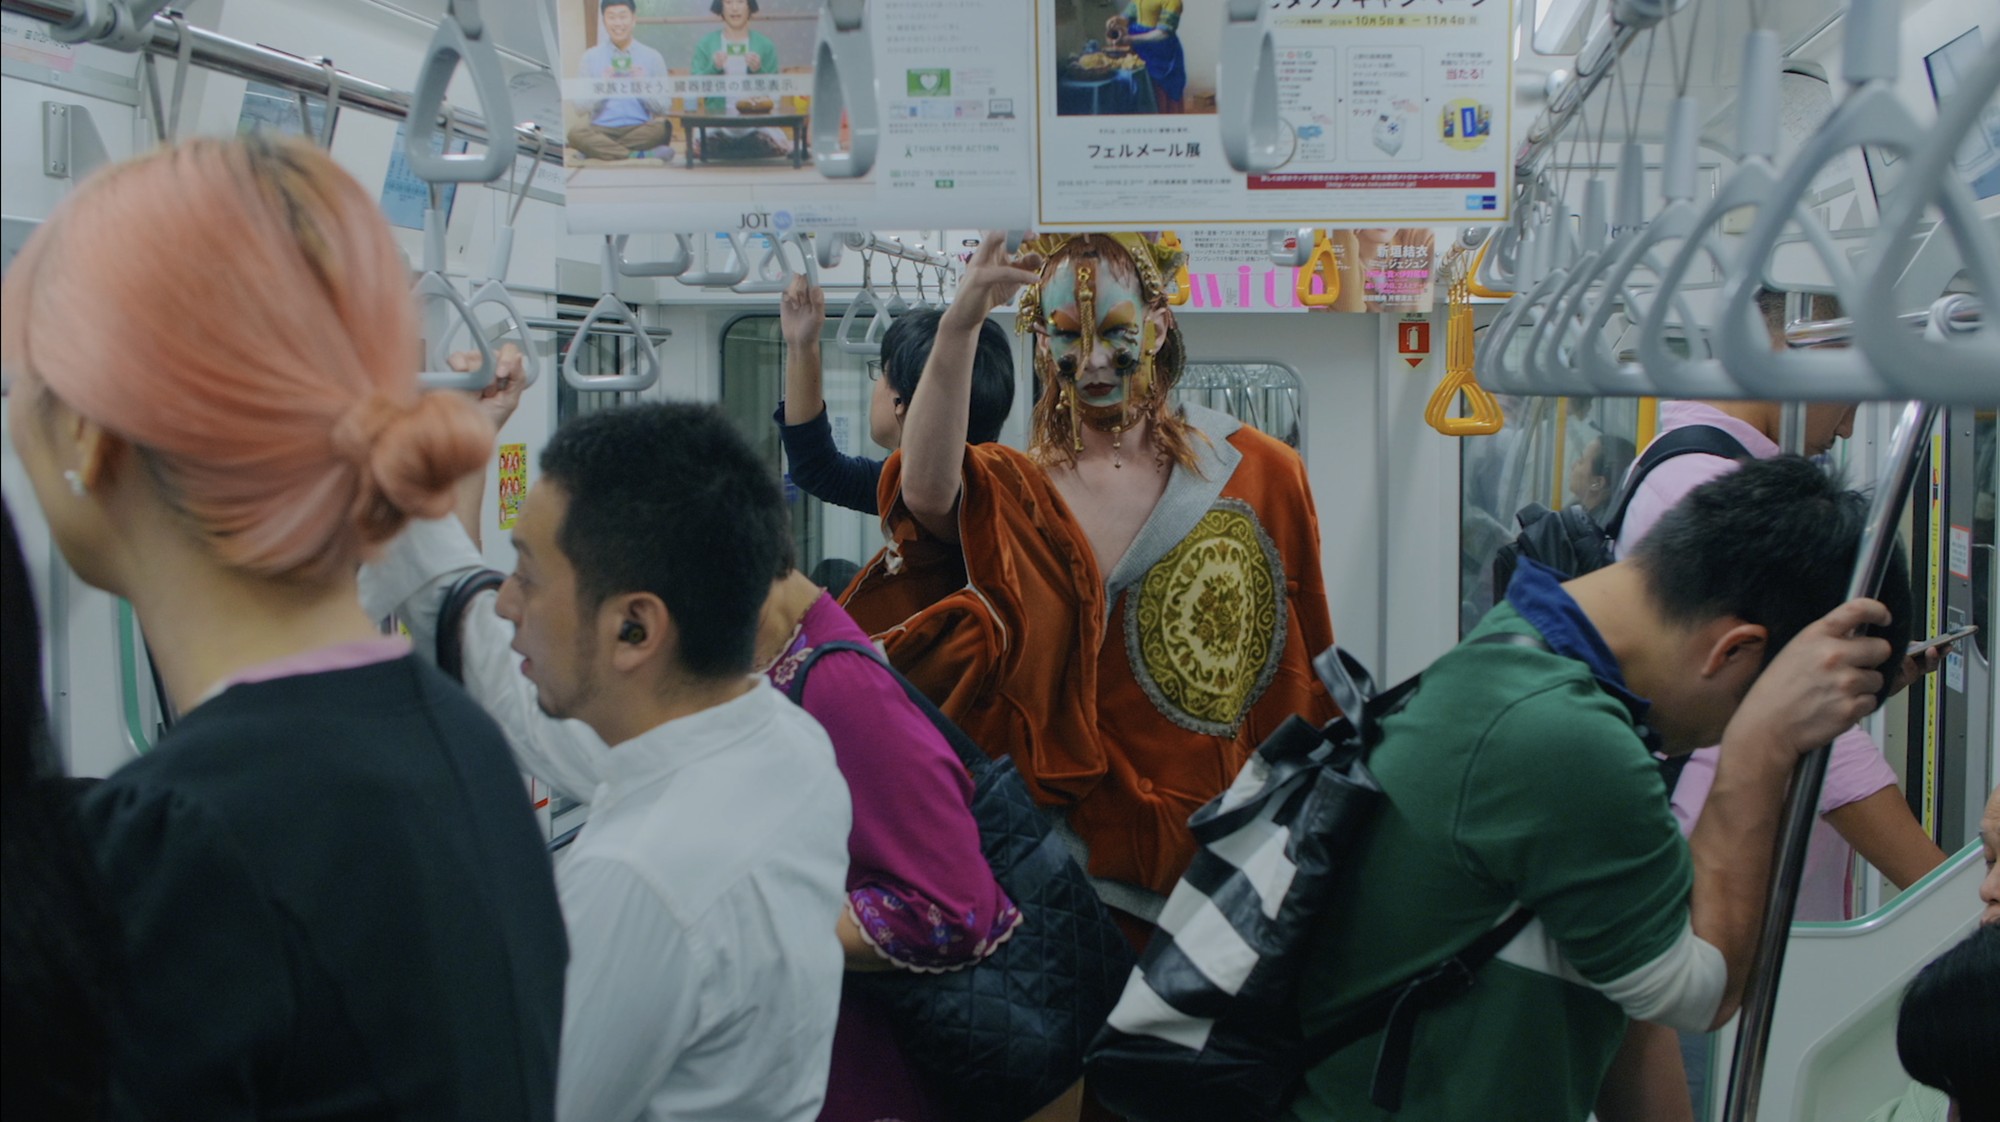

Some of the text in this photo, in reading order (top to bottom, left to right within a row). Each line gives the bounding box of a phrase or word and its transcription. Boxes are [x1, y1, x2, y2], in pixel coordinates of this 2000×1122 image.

[1087, 142, 1201, 159] フェルメール展
[737, 213, 772, 230] JOT
[1376, 244, 1429, 258] 新垣結衣
[1188, 265, 1330, 309] with
